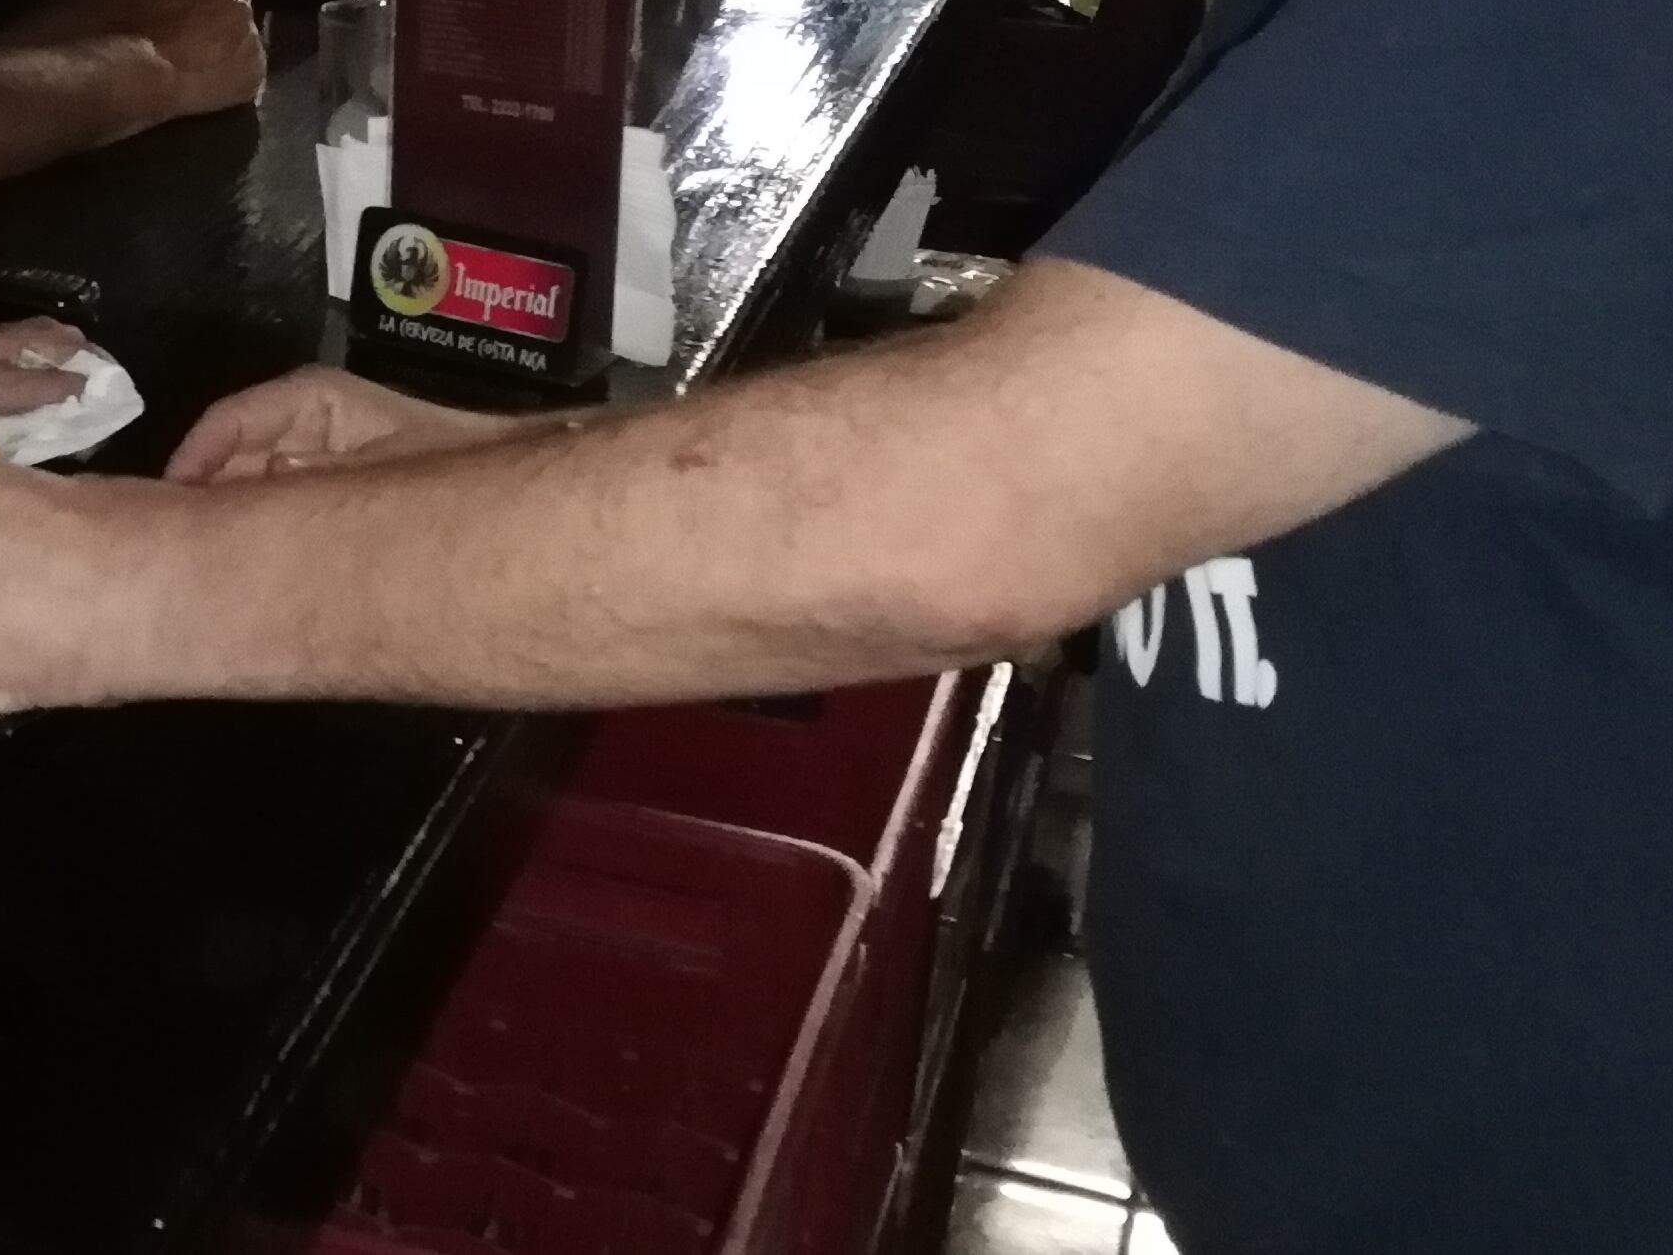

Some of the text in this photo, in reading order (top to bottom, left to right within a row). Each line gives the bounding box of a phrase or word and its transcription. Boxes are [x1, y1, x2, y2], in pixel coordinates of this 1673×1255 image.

[454, 262, 561, 322] Imperial
[379, 314, 548, 372] LA CERVEZA DE COSTA RICA
